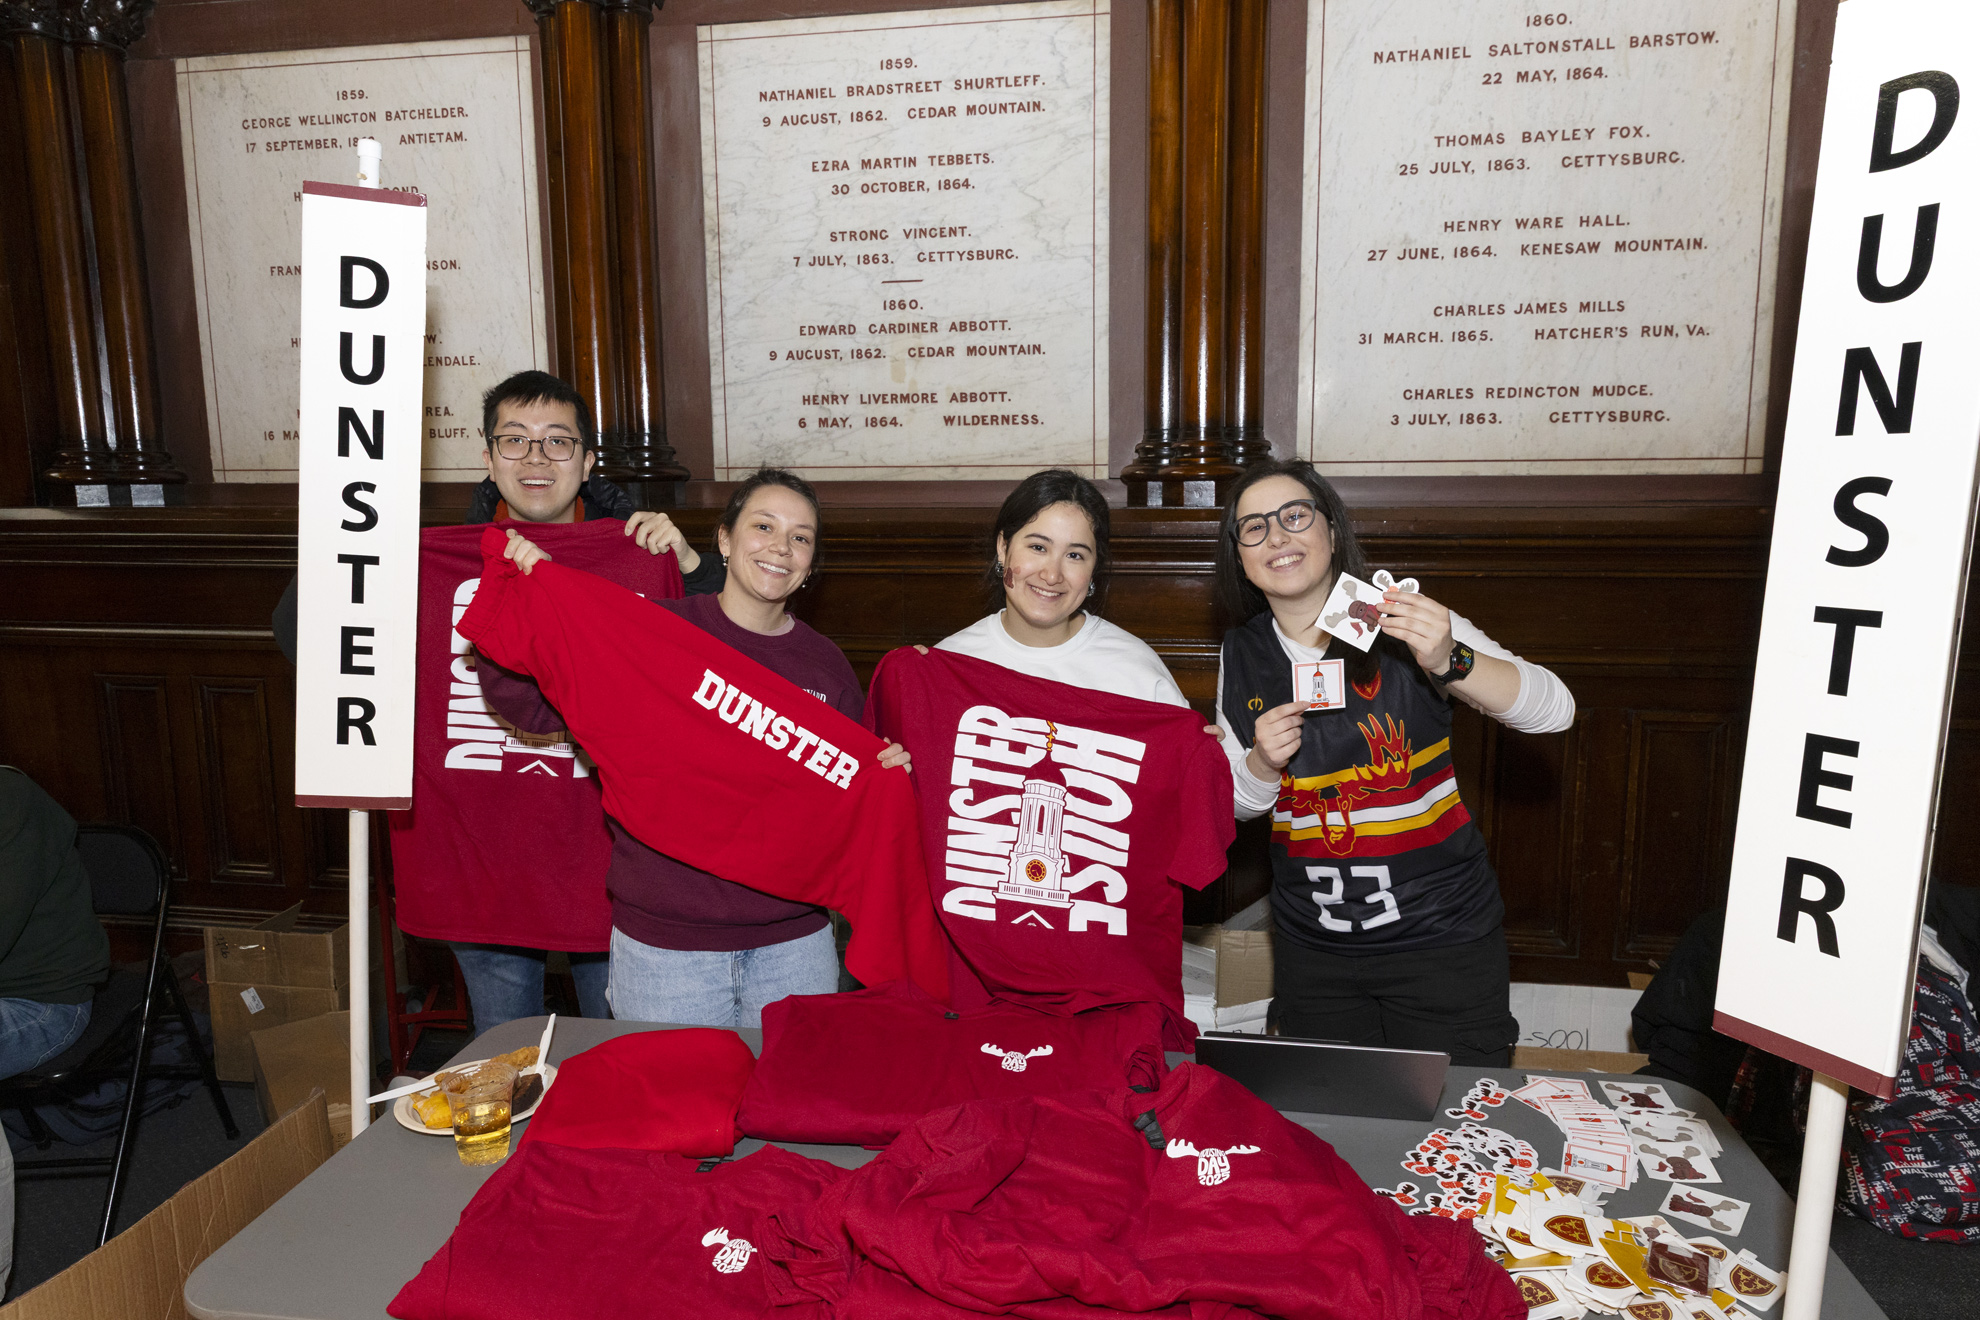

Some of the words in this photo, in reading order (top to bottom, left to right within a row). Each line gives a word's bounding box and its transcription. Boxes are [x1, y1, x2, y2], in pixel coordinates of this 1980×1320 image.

[1525, 12, 1573, 28] 1860.
[1373, 45, 1472, 65] NATHANIEL
[1487, 36, 1616, 58] SALTONSTALL
[1629, 30, 1720, 49] BARSTOW.
[879, 56, 918, 71] 1859.
[1481, 71, 1503, 86] 22
[1515, 68, 1557, 84] MAY,
[1566, 66, 1609, 81] 1864.
[336, 89, 369, 102] 1859.
[758, 87, 837, 103] NATHANIEL
[846, 79, 943, 98] BRADSTREET
[953, 74, 1046, 91] SHURTLEFF.
[384, 106, 469, 122] BATCHELDER.
[761, 115, 772, 128] 9
[850, 109, 888, 123] 1862.
[907, 105, 957, 120] CEDAR
[965, 100, 1046, 117] MOUNTAIN.
[245, 142, 257, 154] 17
[265, 137, 343, 153] SEPTEMBER,
[398, 130, 468, 146] ANTIETAM.
[1433, 132, 1506, 148] THOMAS
[1521, 127, 1596, 144] BAYLEY
[1608, 125, 1651, 140] FOX.
[811, 159, 851, 173] EZRA
[860, 156, 917, 171] MARTIN
[927, 152, 995, 167] TEBBETS.
[1398, 162, 1419, 177] 25
[1428, 160, 1476, 176] JULY,
[1487, 157, 1531, 173] 1863.
[830, 183, 851, 196] 30
[860, 180, 931, 195] OCTOBER,
[937, 177, 976, 191] 1864.
[902, 225, 972, 240] VINCENT.
[1443, 218, 1503, 233] HENRY
[1514, 216, 1564, 230] WARE
[1578, 213, 1631, 228] HALL.
[1366, 248, 1389, 262] 27
[1396, 247, 1445, 261] JUNE,
[1453, 245, 1498, 259] 1864.
[1520, 240, 1602, 257] KENESAW
[1614, 236, 1708, 254] MOUNTAIN.
[269, 264, 302, 277] FRAN
[425, 259, 461, 271] NSON.
[792, 256, 801, 268] 7
[807, 254, 847, 268] JULY,
[856, 252, 895, 266] 1863.
[882, 298, 924, 311] 1860.
[1432, 303, 1506, 318] CHARLES
[1513, 301, 1568, 315] JAMES
[1578, 299, 1626, 314] MILLS
[799, 323, 857, 337] EDWARD
[948, 319, 1012, 333] ABBOTT.
[1357, 332, 1373, 346] 31
[1451, 329, 1494, 343] 1865.
[1640, 324, 1680, 339] RUN,
[768, 350, 778, 362] 9
[850, 347, 887, 360] 1862.
[907, 345, 955, 359] CEDAR
[966, 343, 1046, 357] MOUNTAIN.
[801, 390, 850, 406] HENRY
[859, 392, 939, 405] LIVERMORE
[948, 390, 1012, 404] ABBOTT.
[1402, 387, 1475, 401] CHARLES
[797, 416, 808, 429] 6
[817, 416, 853, 430] MAY,
[864, 415, 904, 429] 1864.
[942, 413, 1045, 427] WILDERNESS.
[1390, 413, 1400, 426] 3
[1407, 413, 1451, 427] JULY,
[1459, 412, 1503, 426] 1863.
[263, 430, 275, 442] 16
[336, 255, 389, 746] DUNSTER
[1777, 70, 1960, 958] DUNSTER
[692, 669, 860, 790] DUNSTER
[942, 705, 1050, 921] DUNSTER
[1051, 722, 1146, 936] HOUSE
[1305, 865, 1401, 932] 23
[1002, 1056, 1027, 1068] DAY
[1932, 1058, 1944, 1068] OFF
[1961, 1140, 1977, 1148] THE
[1198, 1156, 1230, 1176] DAY
[1198, 1171, 1230, 1186] 2025
[714, 1247, 751, 1267] DAY
